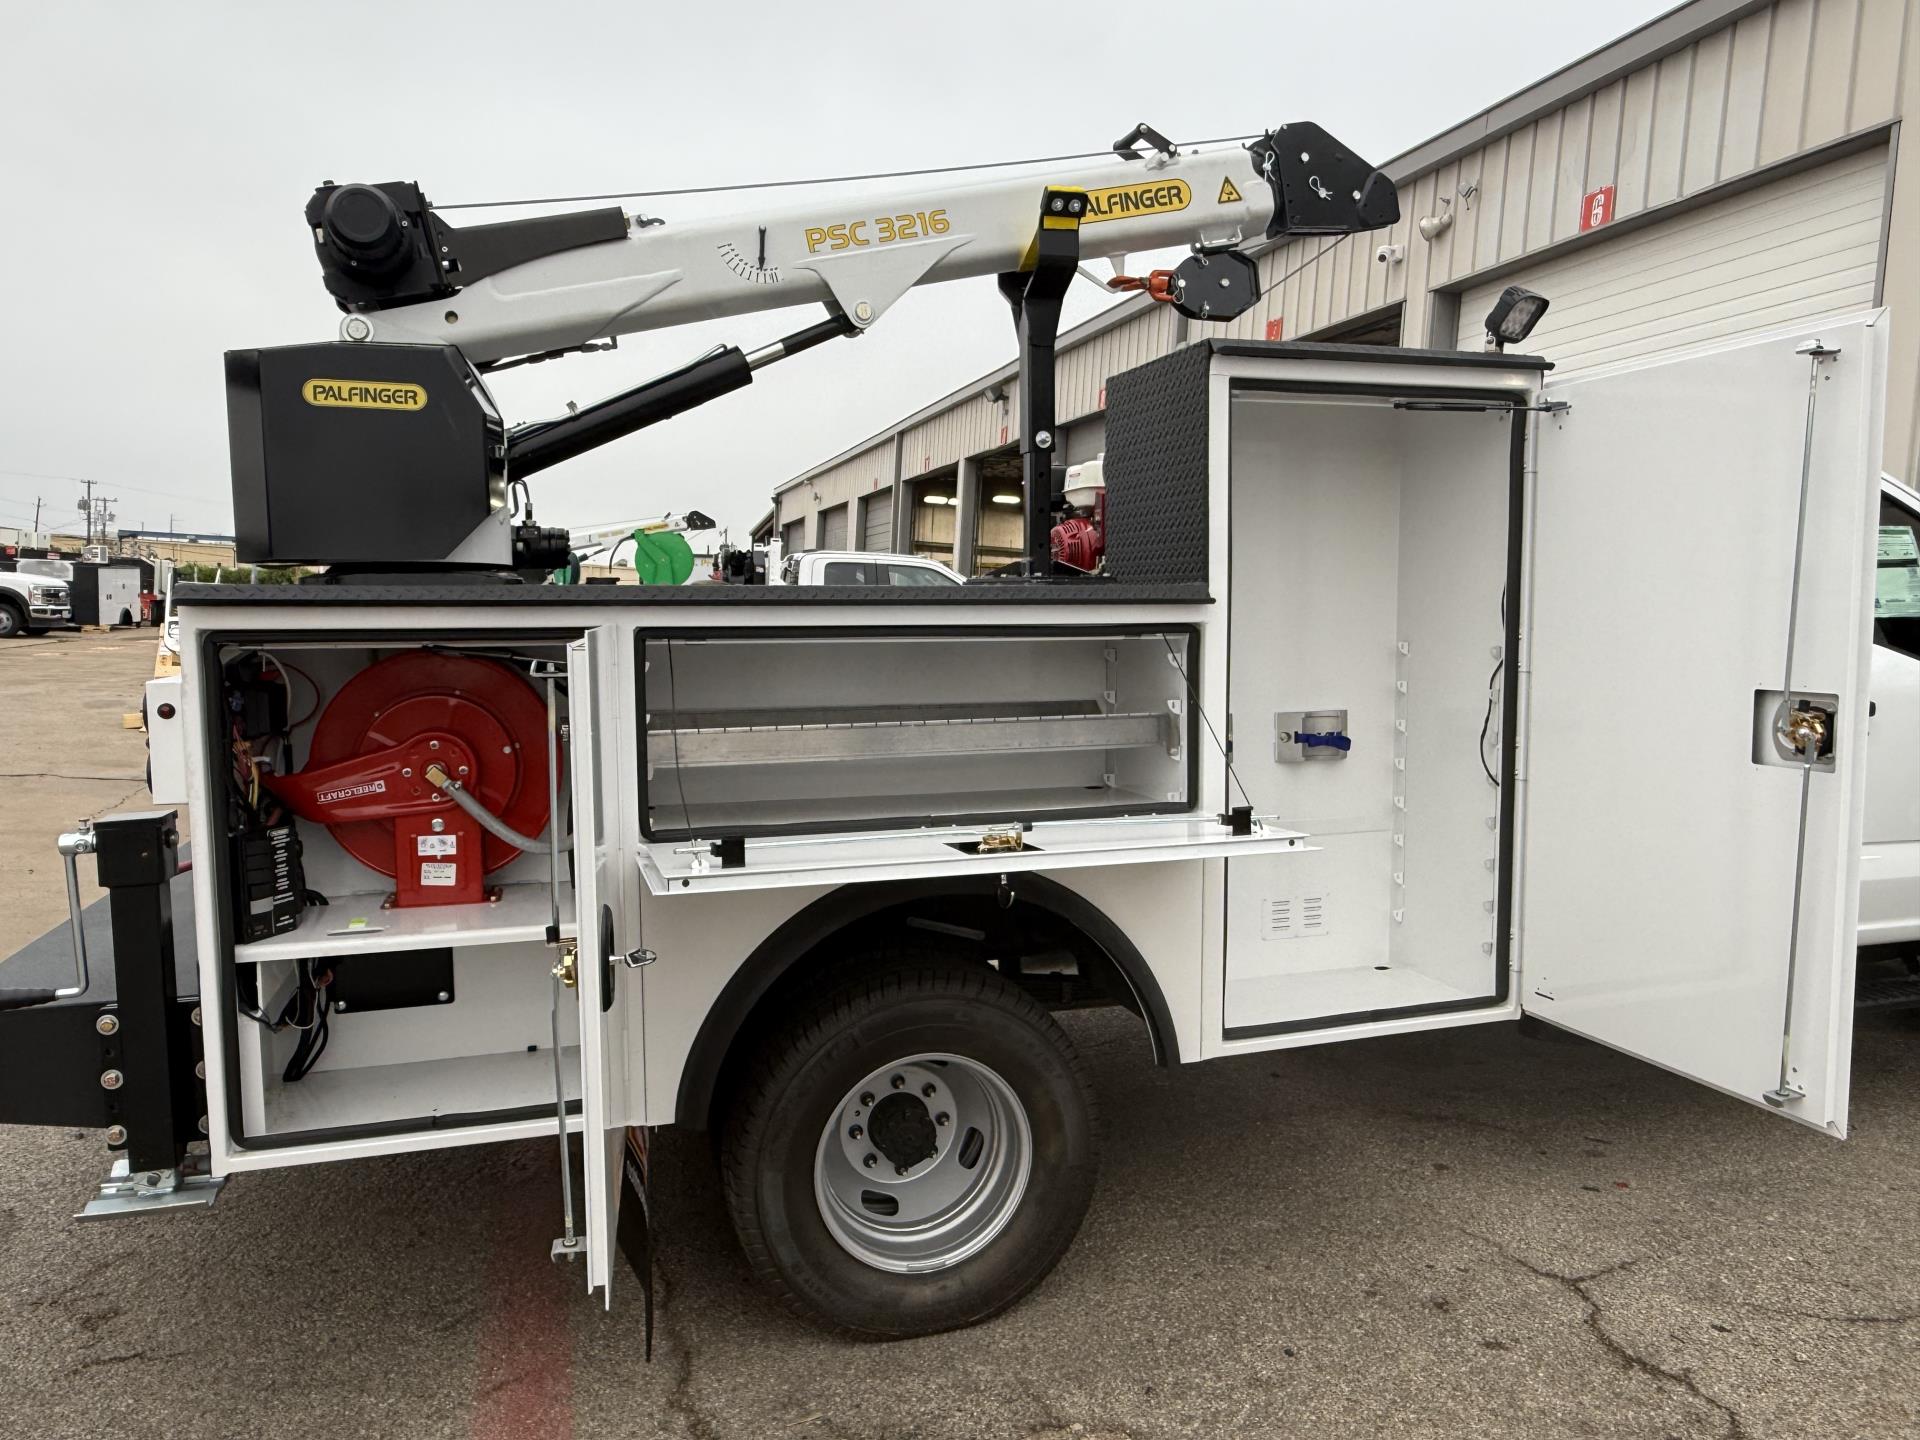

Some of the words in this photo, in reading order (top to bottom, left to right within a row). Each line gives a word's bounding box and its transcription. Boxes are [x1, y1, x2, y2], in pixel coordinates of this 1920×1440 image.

[1086, 185, 1184, 217] ALFINGER
[804, 221, 870, 253] PSC
[875, 209, 950, 243] 3216
[312, 384, 418, 405] PALFINGER
[319, 782, 377, 801] REELCRAFT
